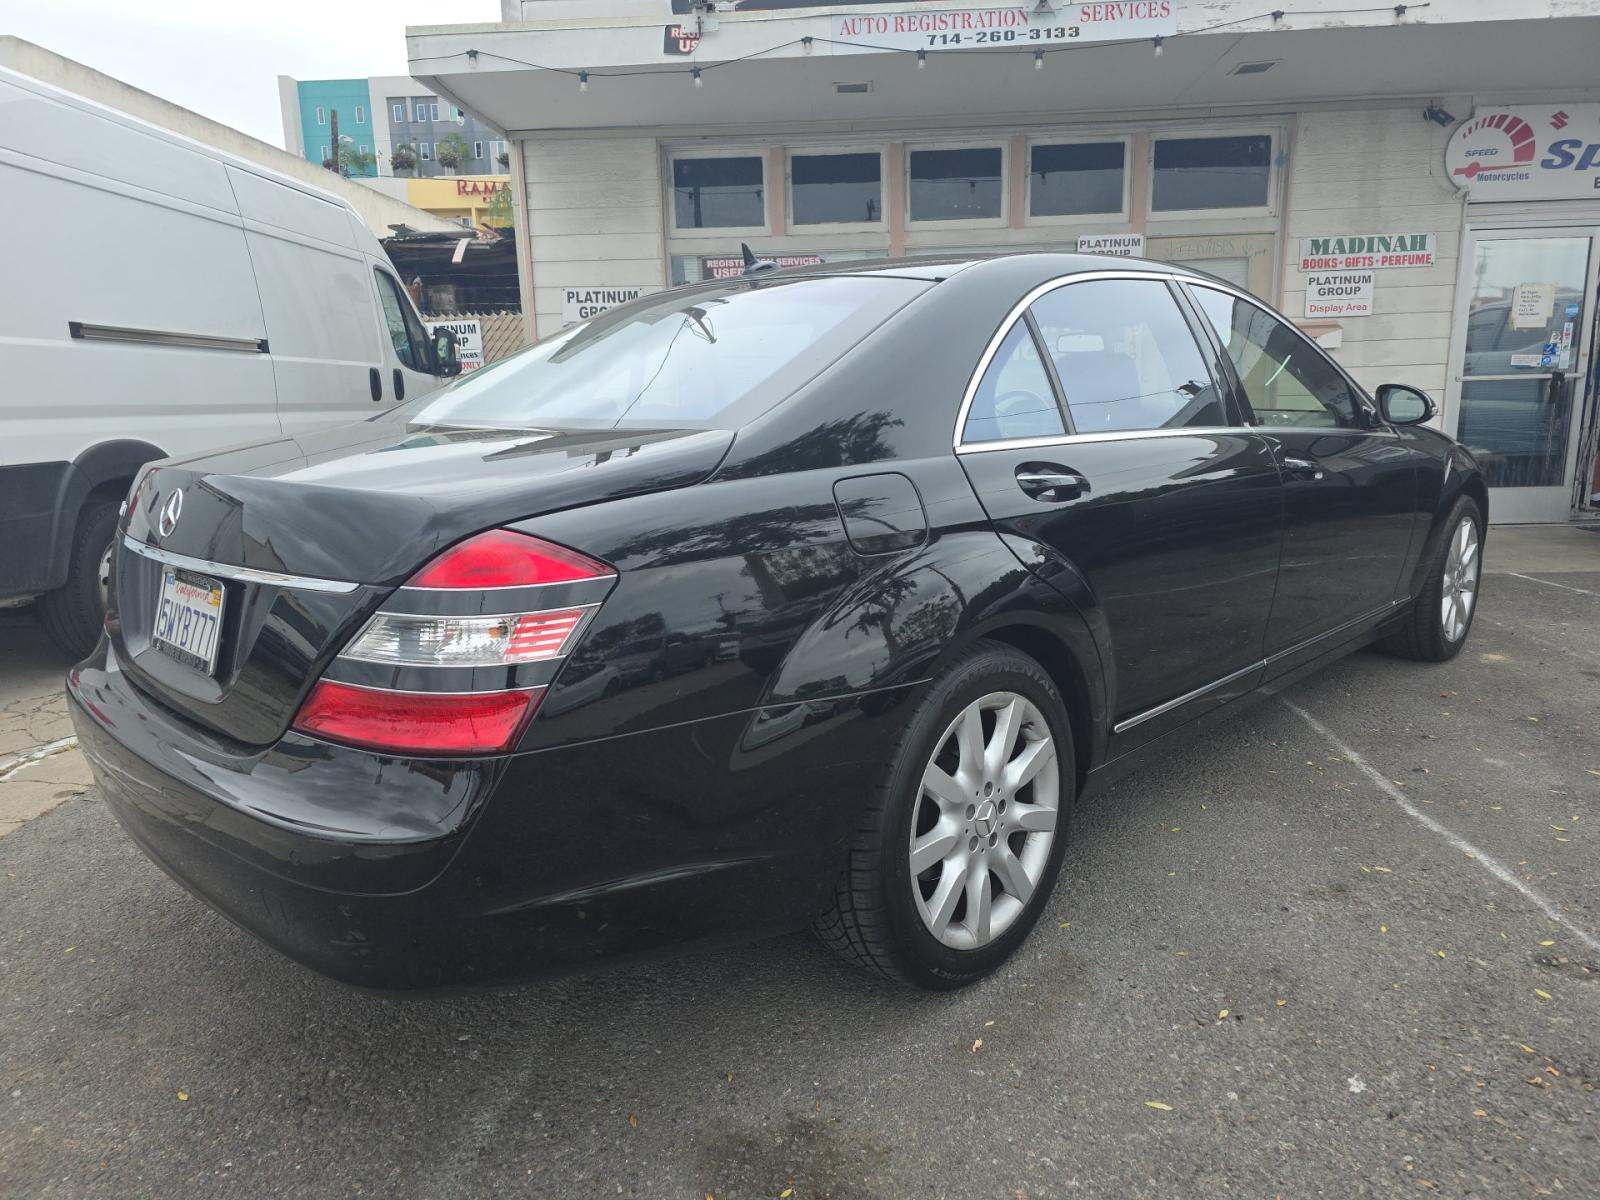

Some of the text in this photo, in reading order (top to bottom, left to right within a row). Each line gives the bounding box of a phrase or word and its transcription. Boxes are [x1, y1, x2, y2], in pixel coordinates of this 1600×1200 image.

[839, 2, 1171, 36] AUTO REGISTRATION SERVICES
[926, 26, 1081, 46] 714-260-3133
[1464, 148, 1499, 158] SPEED
[1477, 171, 1531, 183] Motorcycles
[1079, 237, 1141, 249] PLATINUM
[1310, 234, 1428, 256] MADINAH
[777, 255, 822, 267] SERVICES
[1302, 253, 1432, 270] BOOKS GIFTS PERFUME
[1308, 274, 1372, 286] PLATINUM
[566, 290, 639, 304] PLATINUM
[1317, 286, 1362, 297] GROUP
[1309, 302, 1368, 314] Display Area
[159, 598, 217, 657] 5WYB777
